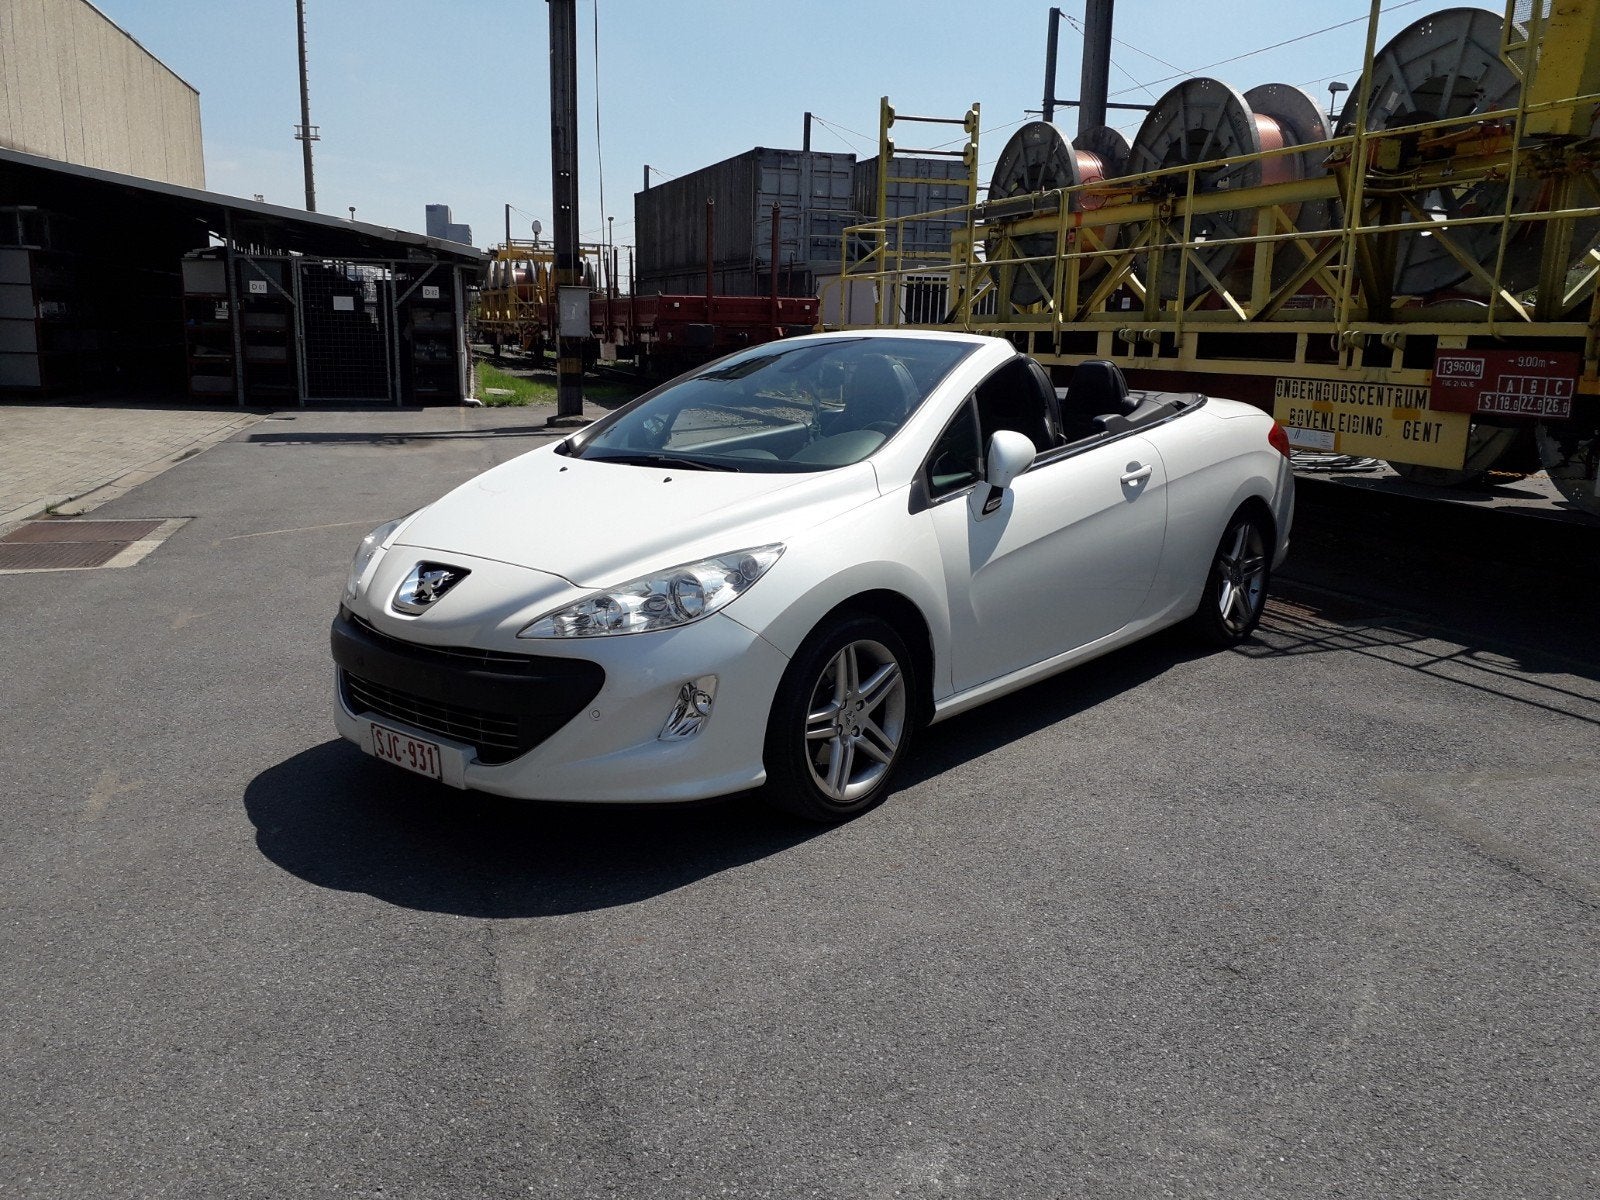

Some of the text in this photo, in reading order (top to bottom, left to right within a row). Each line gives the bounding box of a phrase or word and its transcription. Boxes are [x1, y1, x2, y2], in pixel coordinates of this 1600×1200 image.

[1276, 379, 1428, 410] ONDERHOUDSCENTRUM
[1506, 380, 1563, 395] A B C
[1485, 395, 1491, 409] S
[1289, 408, 1383, 437] BOVENLEIDING
[1402, 420, 1442, 443] GENT
